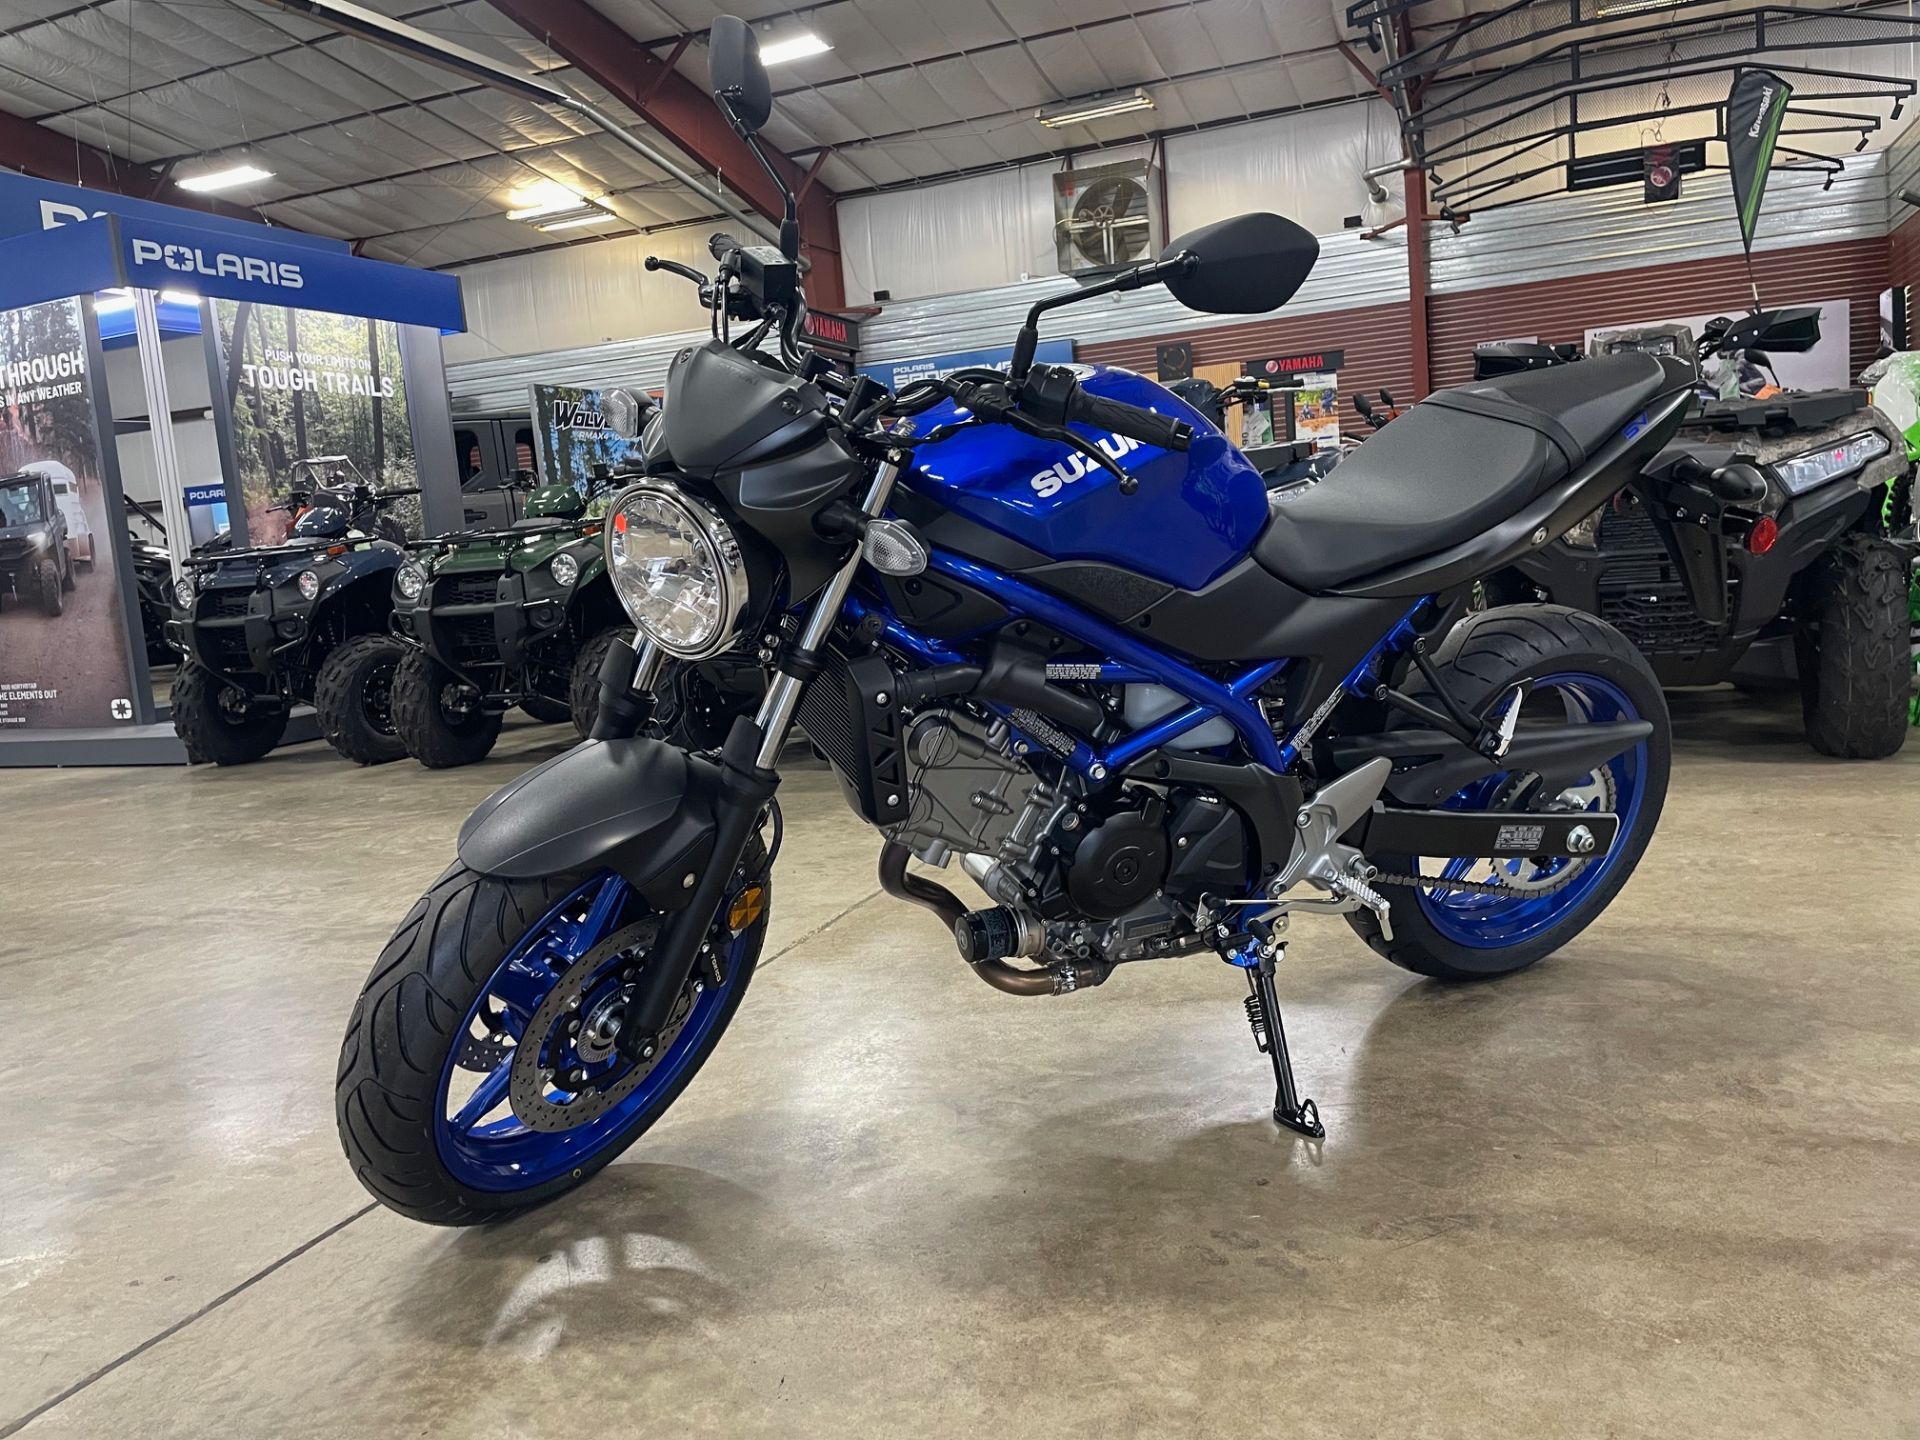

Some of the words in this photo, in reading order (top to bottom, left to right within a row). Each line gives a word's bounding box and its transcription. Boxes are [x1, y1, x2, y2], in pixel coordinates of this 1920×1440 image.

[1748, 86, 1773, 138] Kawasaki
[132, 238, 304, 289] POLARIS
[813, 316, 848, 343] YAMAHA
[264, 349, 293, 363] PUSH
[295, 351, 323, 365] YOUR
[358, 359, 371, 371] ON
[893, 363, 935, 375] POLARIS
[1279, 354, 1324, 372] YAMAHA
[242, 364, 318, 392] TOUGH
[322, 371, 394, 398] TRAILS
[5, 390, 17, 406] IN
[18, 390, 36, 405] ANY
[37, 381, 82, 401] WEATHER
[189, 489, 226, 500] POLARI
[9, 690, 43, 700] ELEMENTS
[44, 689, 57, 699] OUT
